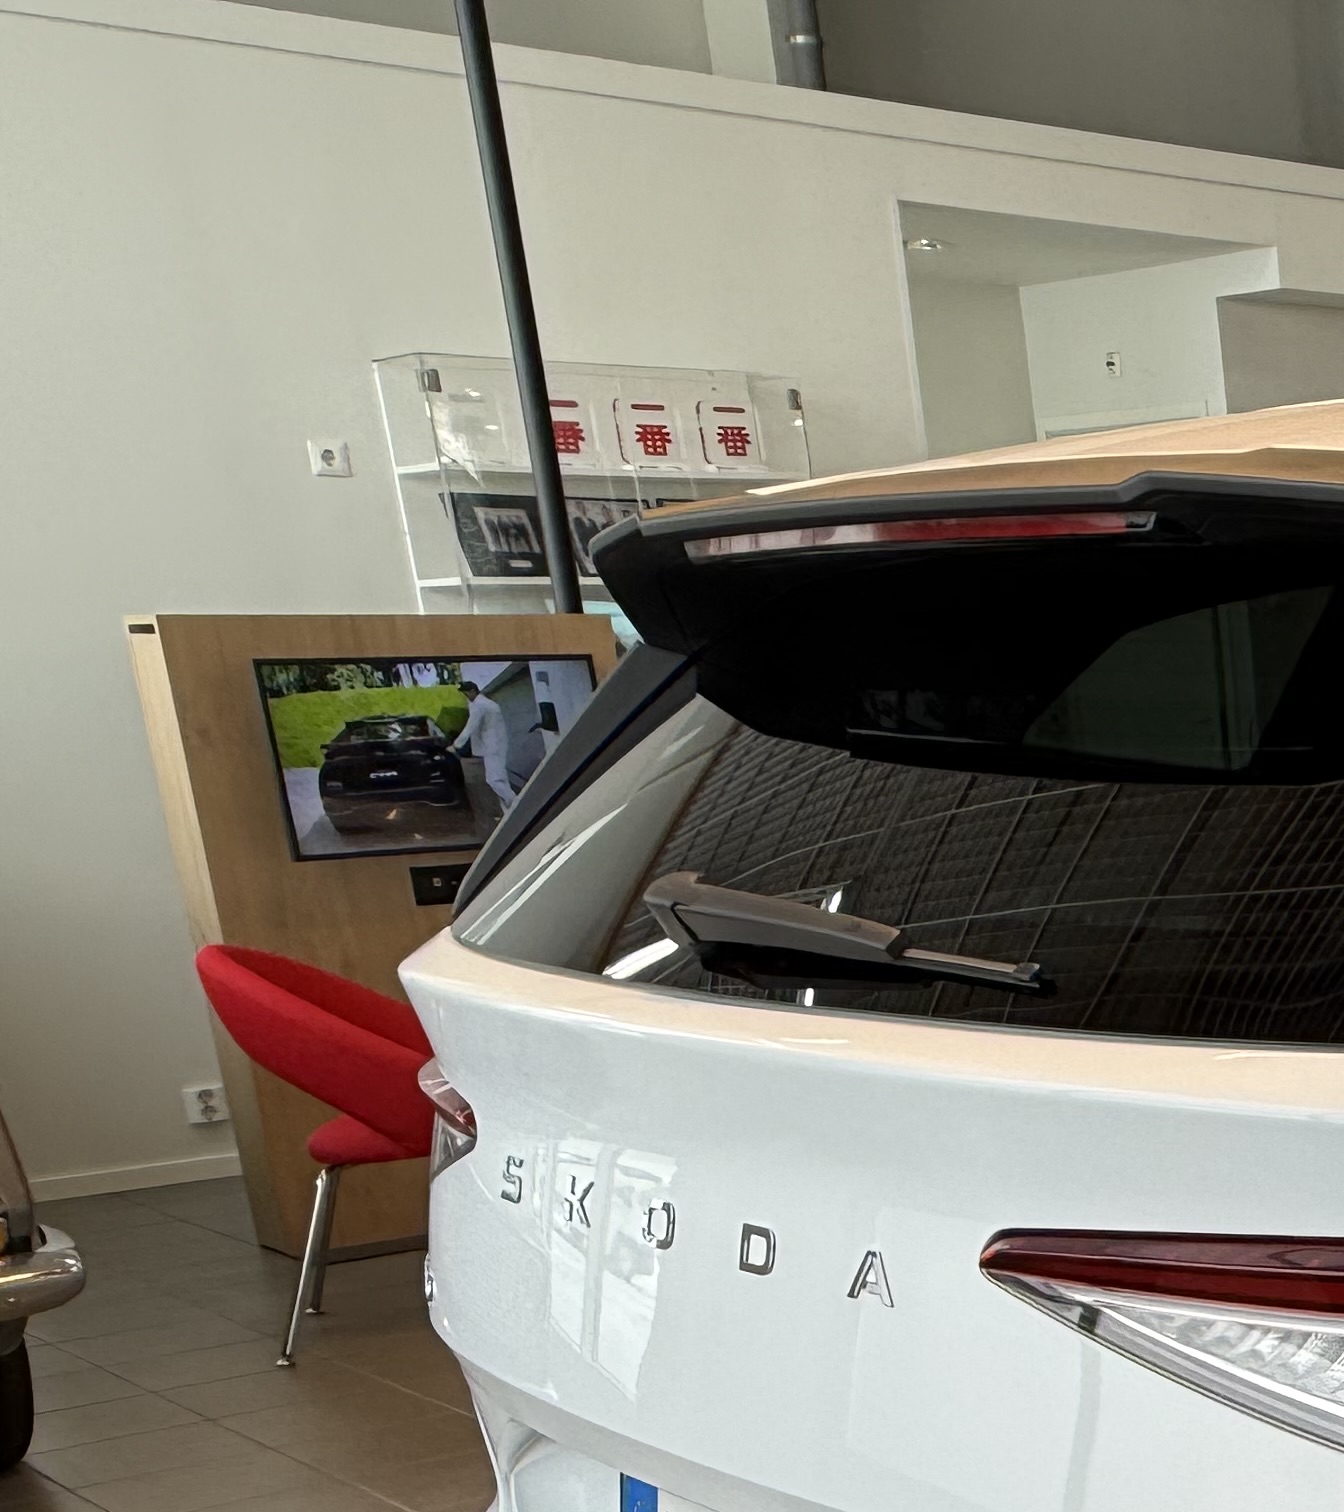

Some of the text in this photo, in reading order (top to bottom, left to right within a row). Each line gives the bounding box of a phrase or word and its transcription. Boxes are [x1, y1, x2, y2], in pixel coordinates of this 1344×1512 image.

[631, 403, 672, 456] 一番
[713, 406, 751, 456] 一番
[500, 1154, 895, 1309] SKODA
